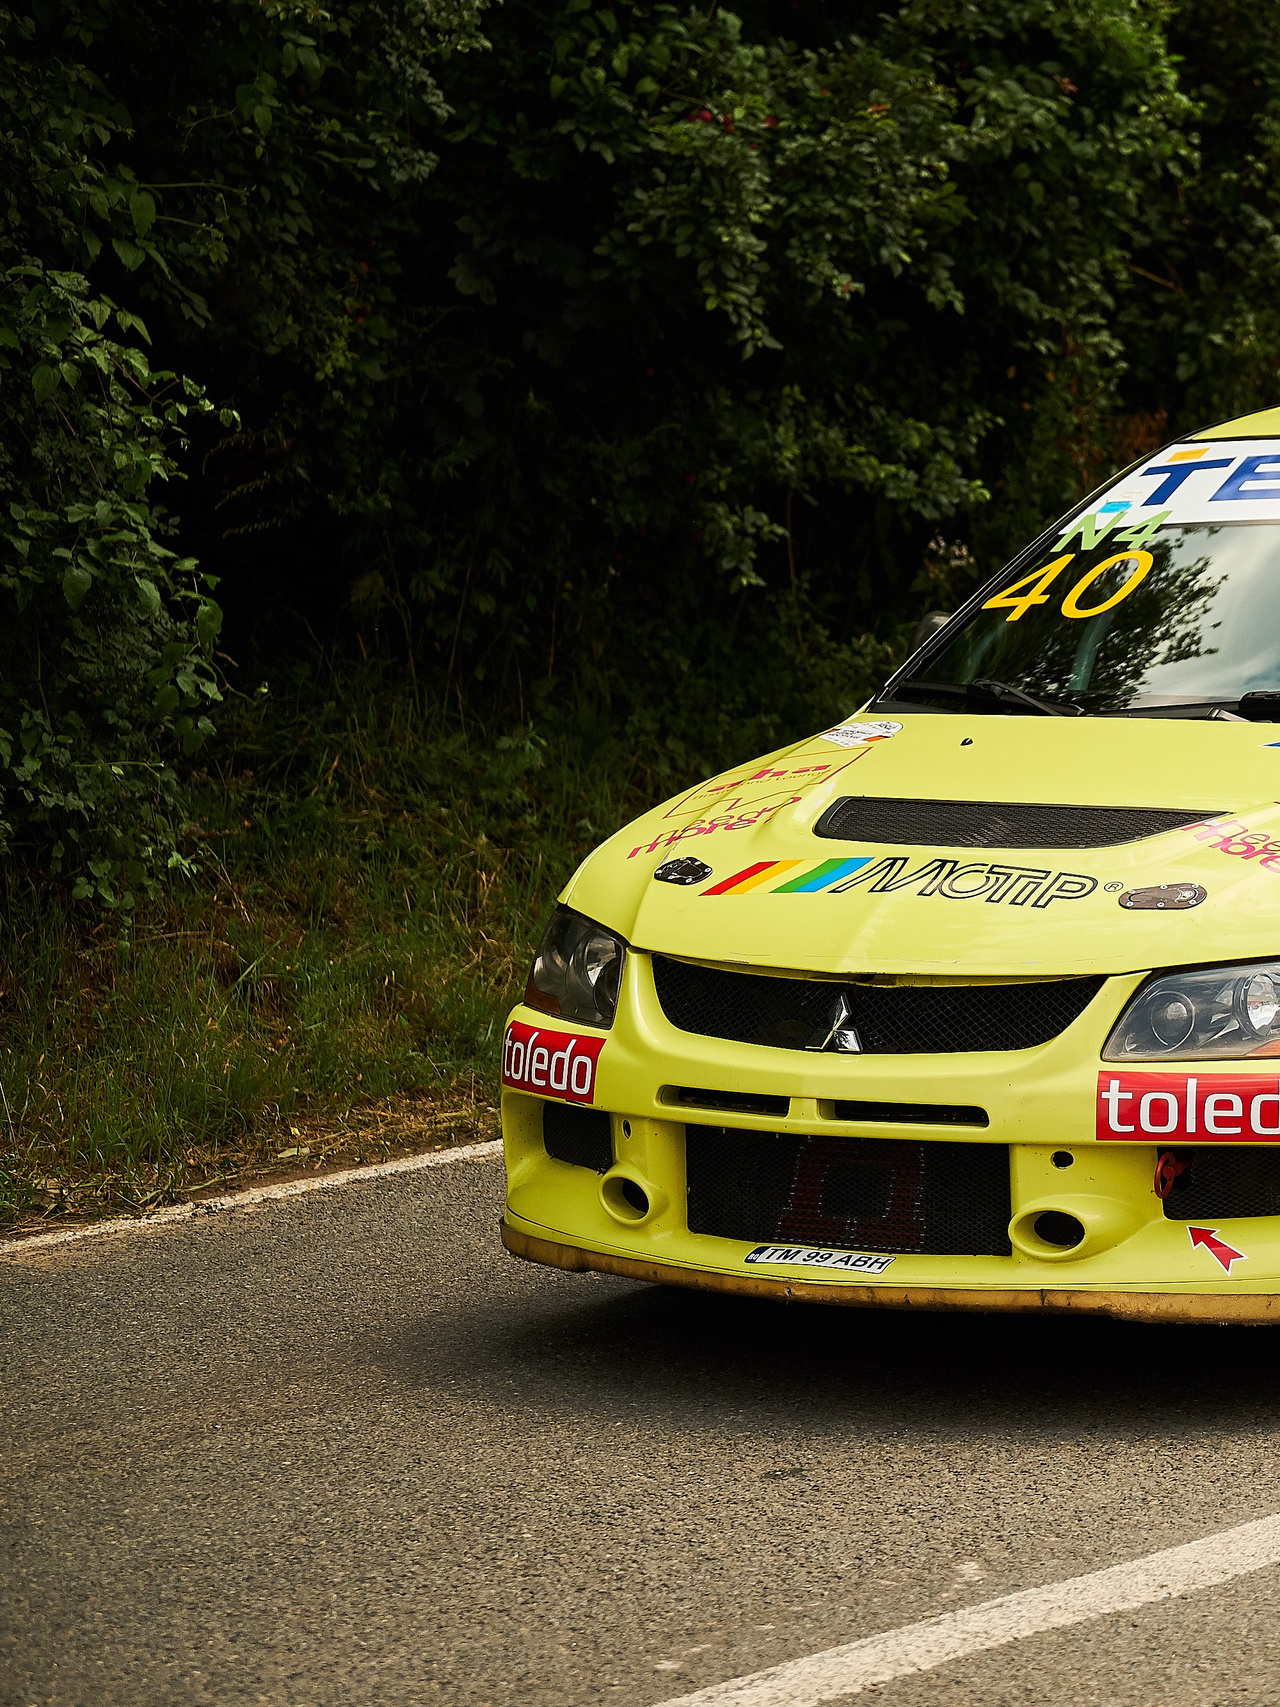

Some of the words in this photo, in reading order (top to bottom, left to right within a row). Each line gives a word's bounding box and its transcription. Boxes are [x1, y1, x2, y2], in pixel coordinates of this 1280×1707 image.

[1050, 510, 1173, 553] N4
[981, 550, 1154, 622] 40
[504, 1028, 593, 1095] toledo
[765, 1248, 803, 1261] TM
[802, 1251, 834, 1263] 99
[832, 1254, 892, 1270] ABH
